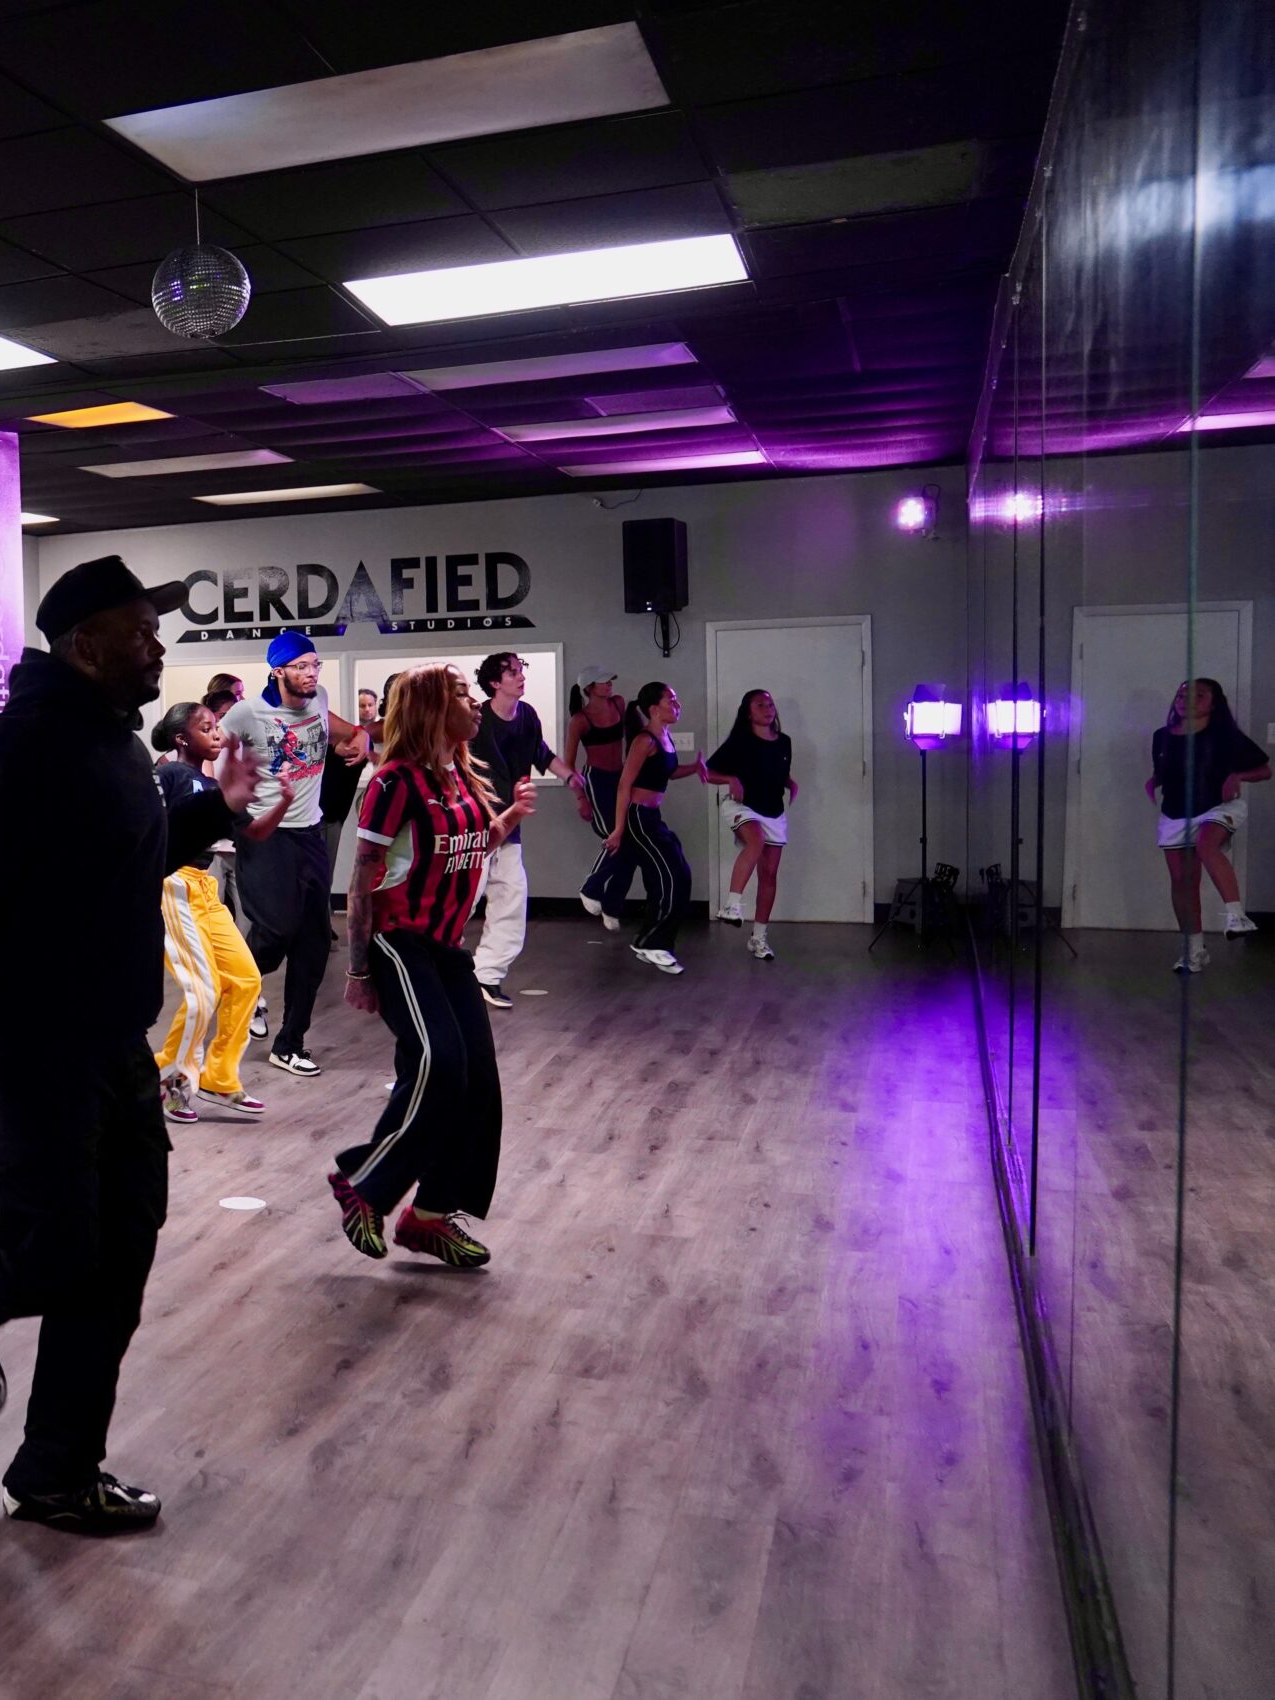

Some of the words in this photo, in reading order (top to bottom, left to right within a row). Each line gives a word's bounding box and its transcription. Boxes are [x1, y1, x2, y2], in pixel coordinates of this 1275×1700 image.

[178, 551, 531, 625] CERDAFIED
[201, 626, 312, 641] DANCE
[392, 616, 512, 631] STUDIOS
